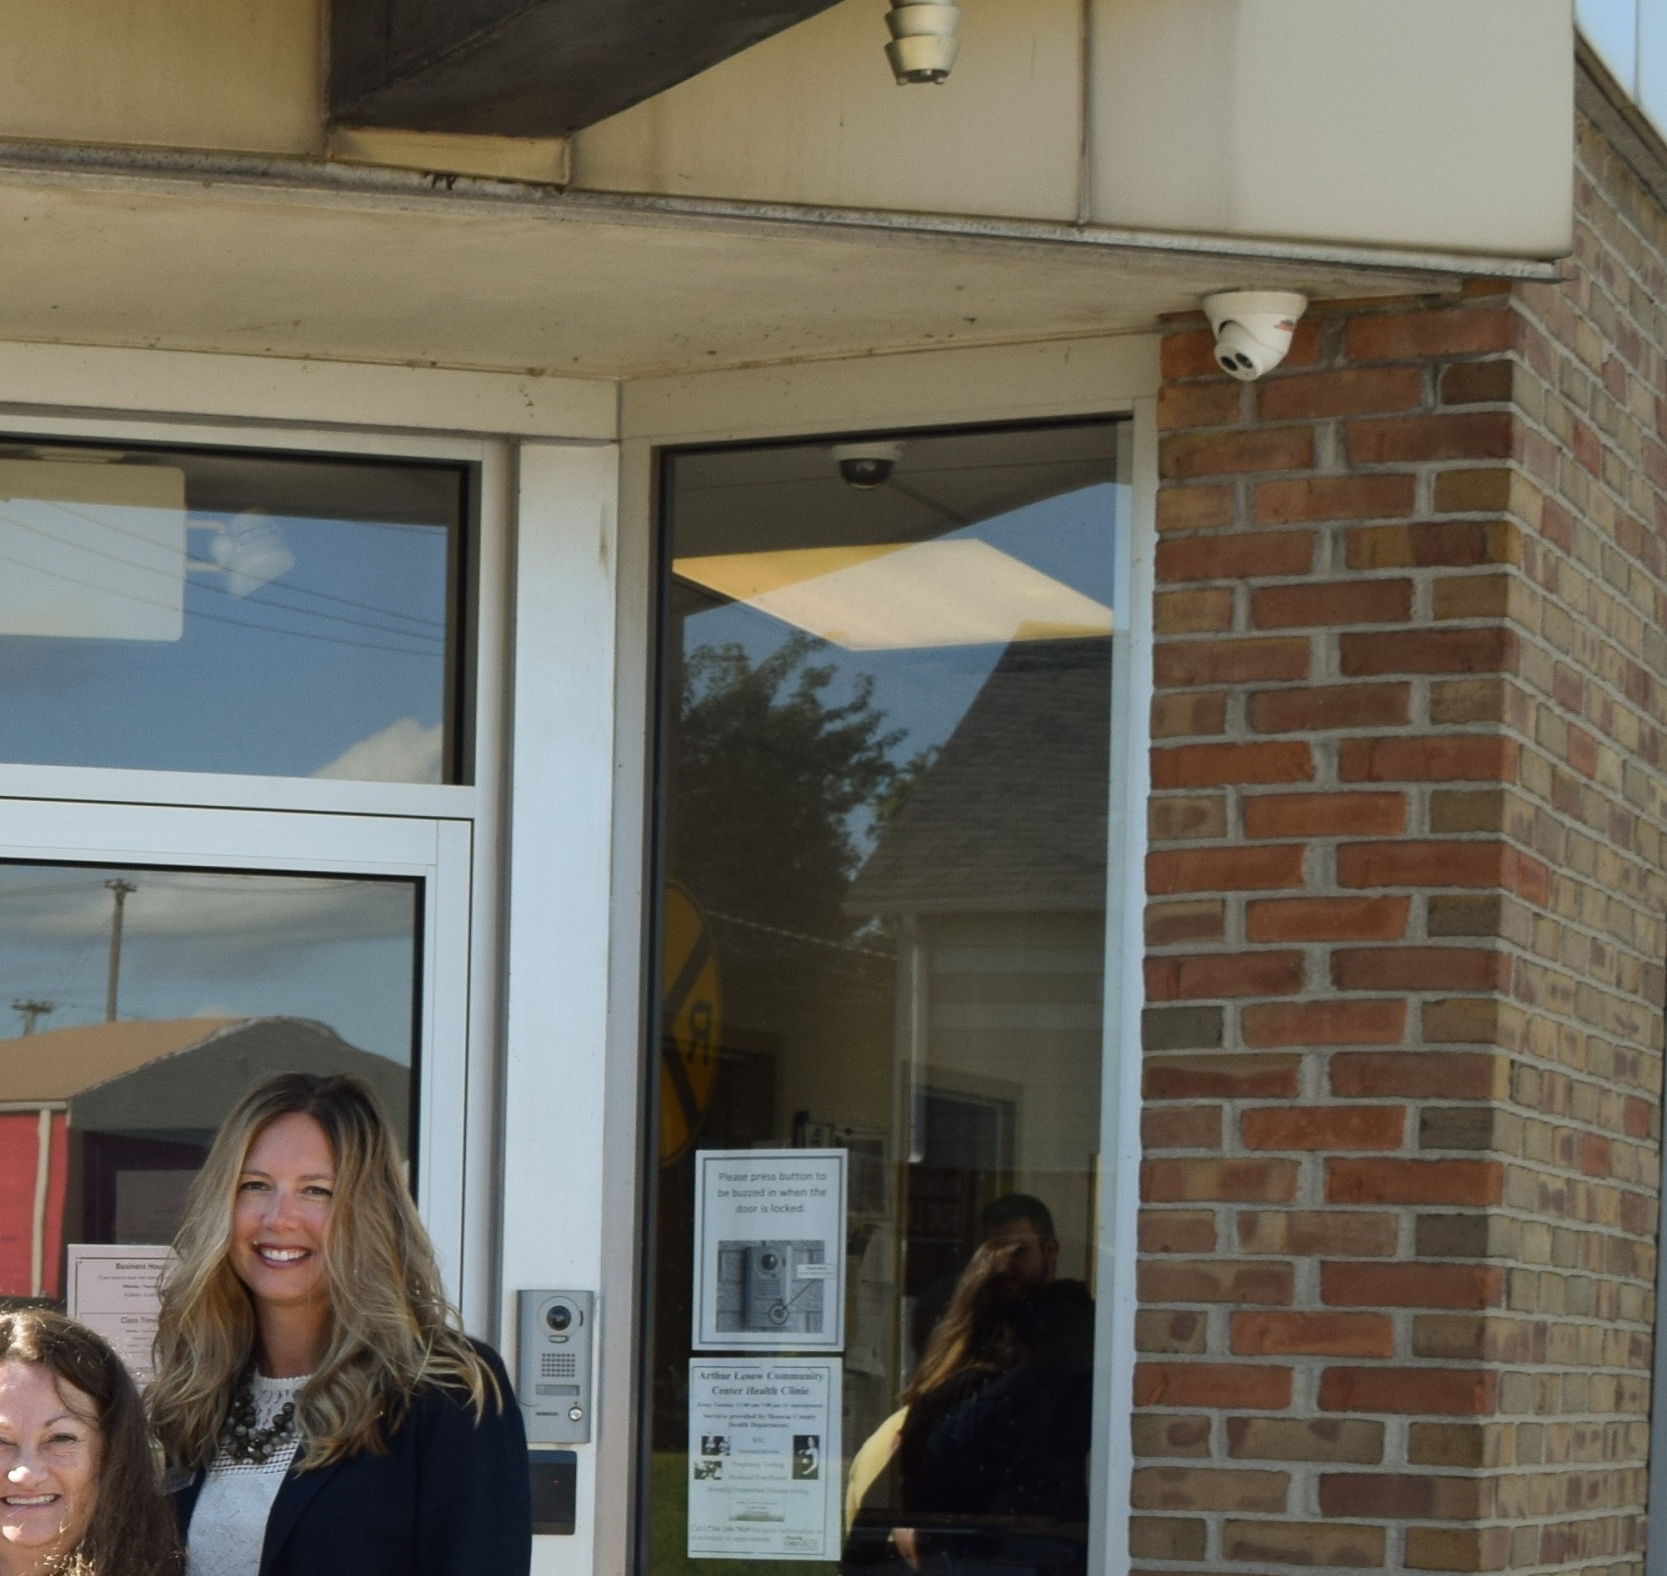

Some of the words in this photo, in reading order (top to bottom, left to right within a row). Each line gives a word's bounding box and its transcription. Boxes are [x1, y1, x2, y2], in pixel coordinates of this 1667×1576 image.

[718, 1172, 748, 1182] Please
[750, 1174, 776, 1183] press
[779, 1172, 812, 1181] button
[815, 1172, 827, 1181] to
[717, 1189, 729, 1198] be
[732, 1188, 765, 1197] buzzed
[768, 1188, 777, 1197] in
[779, 1188, 808, 1197] when
[810, 1188, 827, 1197] the
[735, 1204, 758, 1213] door
[760, 1204, 769, 1213] is
[120, 1316, 139, 1324] Class
[141, 1316, 157, 1324] Time
[700, 1371, 731, 1381] Arthur
[766, 1371, 824, 1383] Community
[711, 1386, 743, 1395] Center
[745, 1386, 778, 1395] Health
[780, 1386, 810, 1396] Clinic
